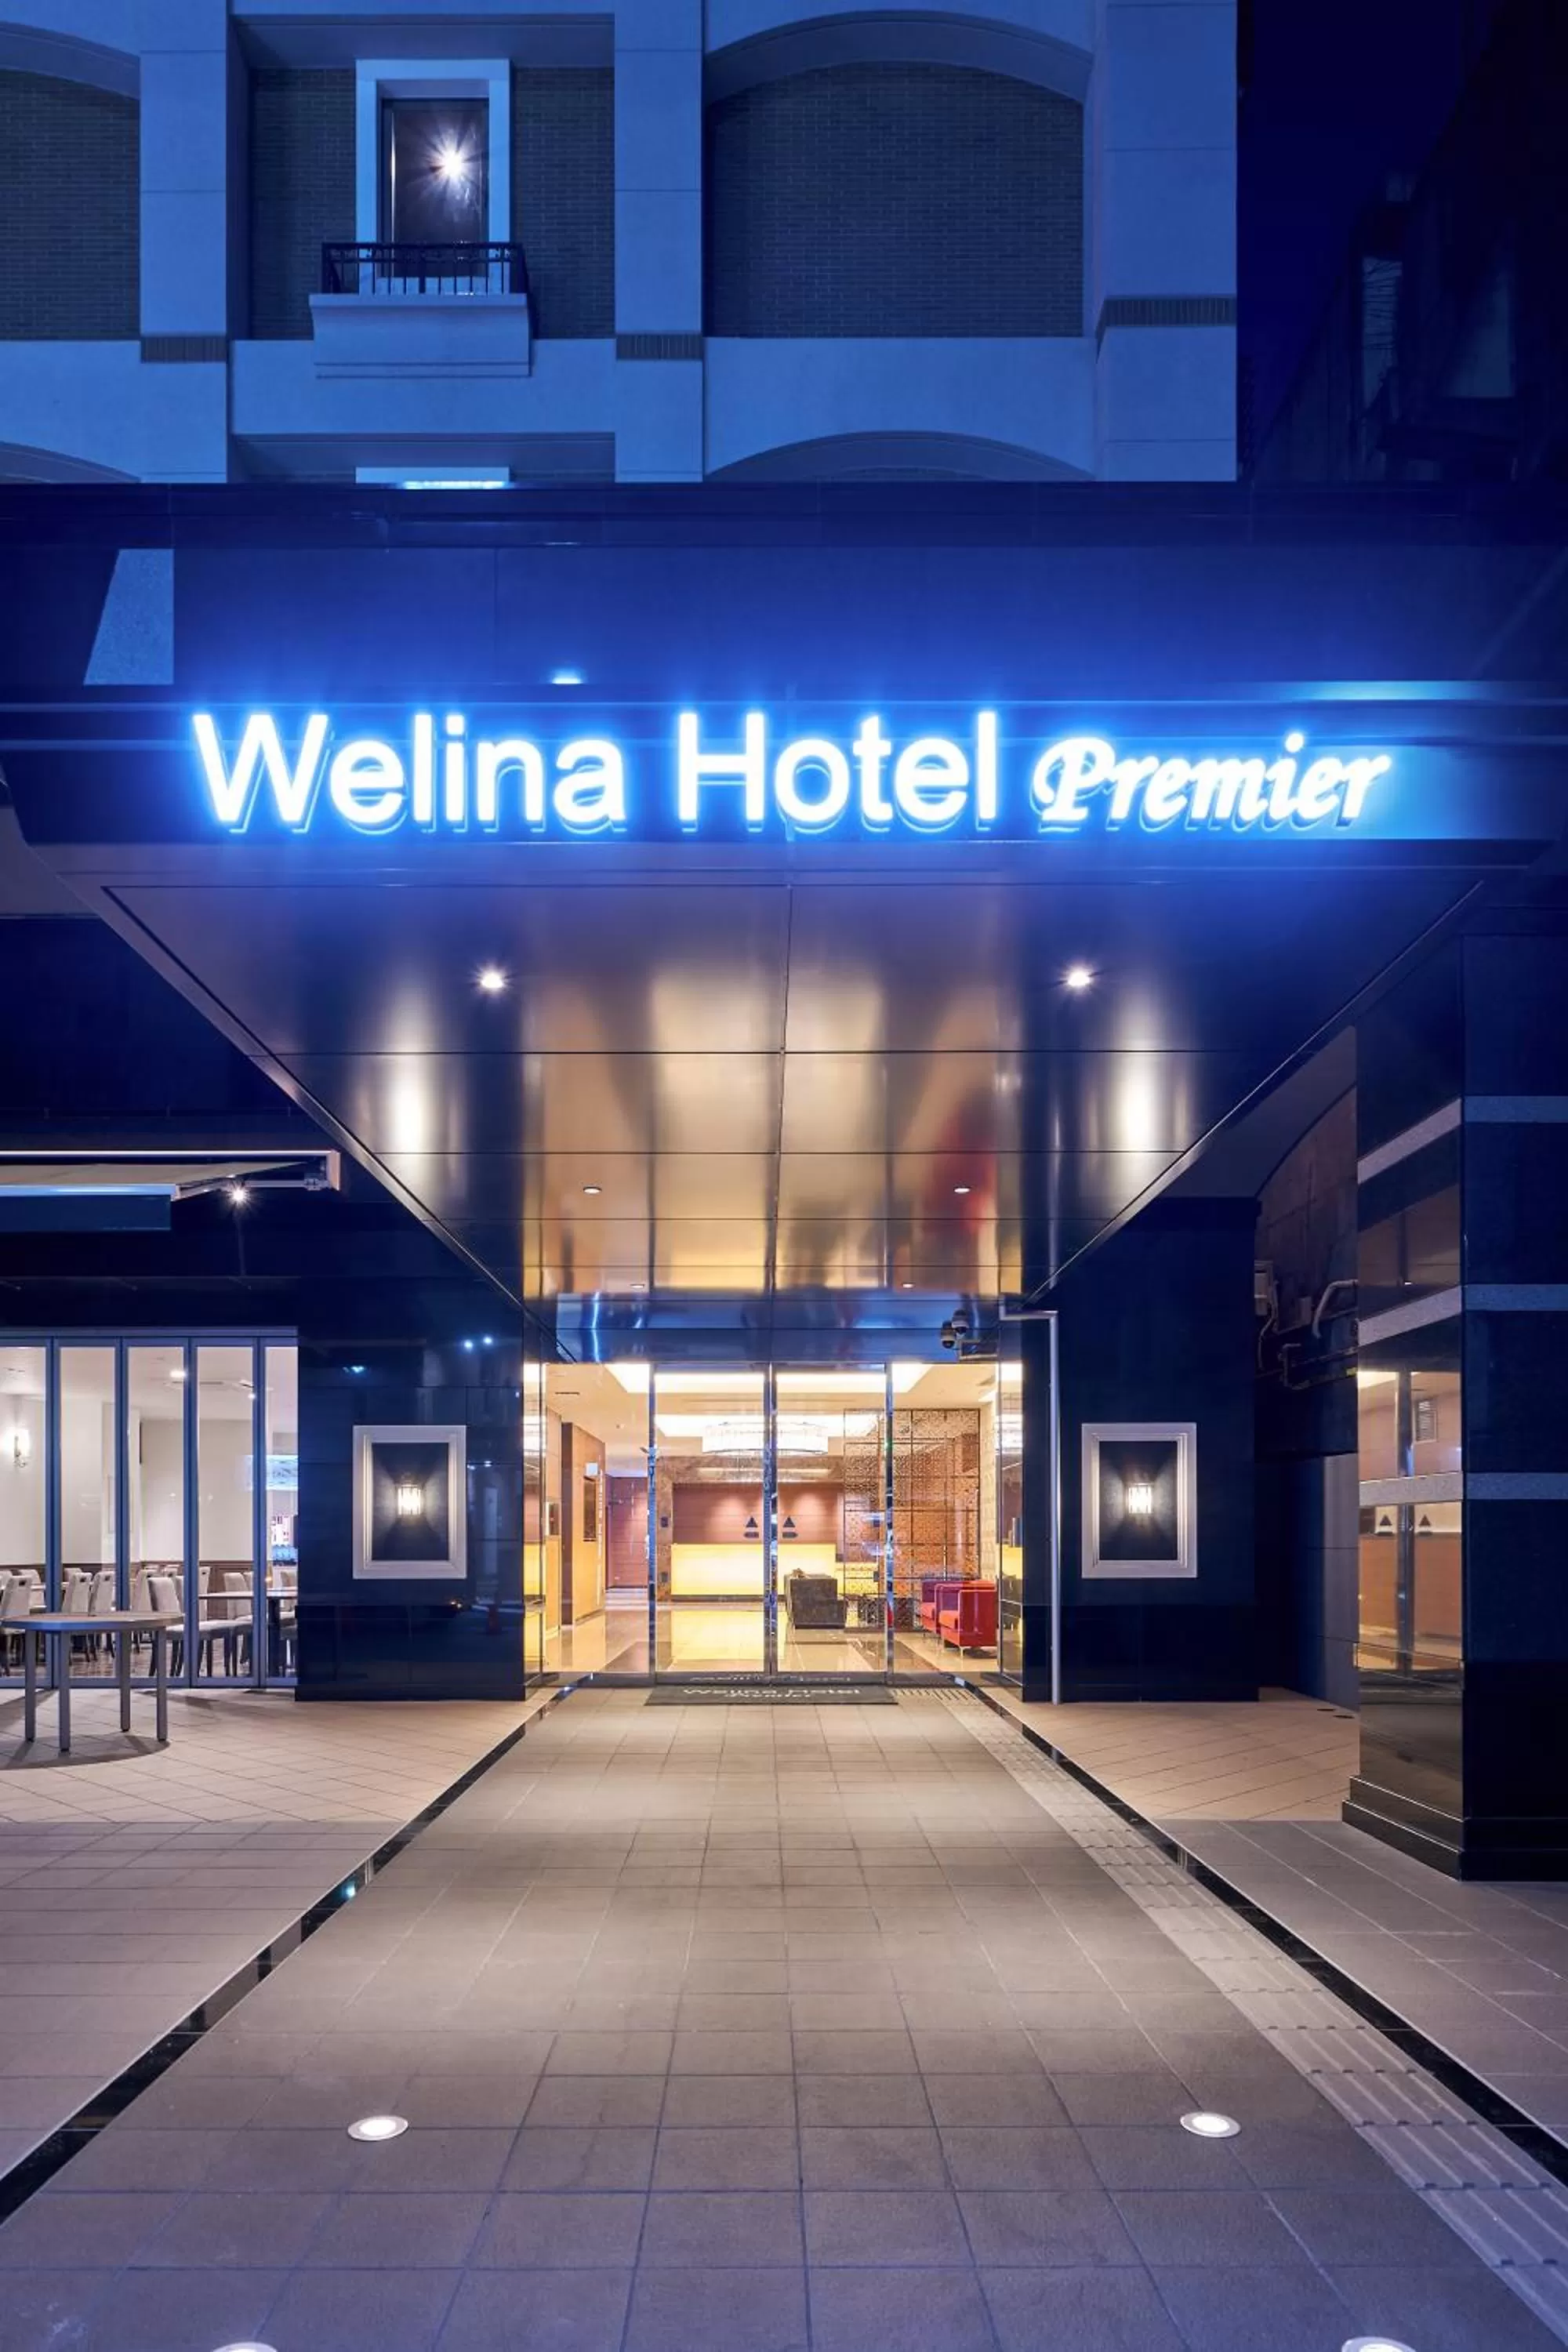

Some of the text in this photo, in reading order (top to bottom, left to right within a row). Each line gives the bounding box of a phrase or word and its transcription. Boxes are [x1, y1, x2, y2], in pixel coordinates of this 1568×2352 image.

[192, 711, 1391, 824] Welina Hotel Premier
